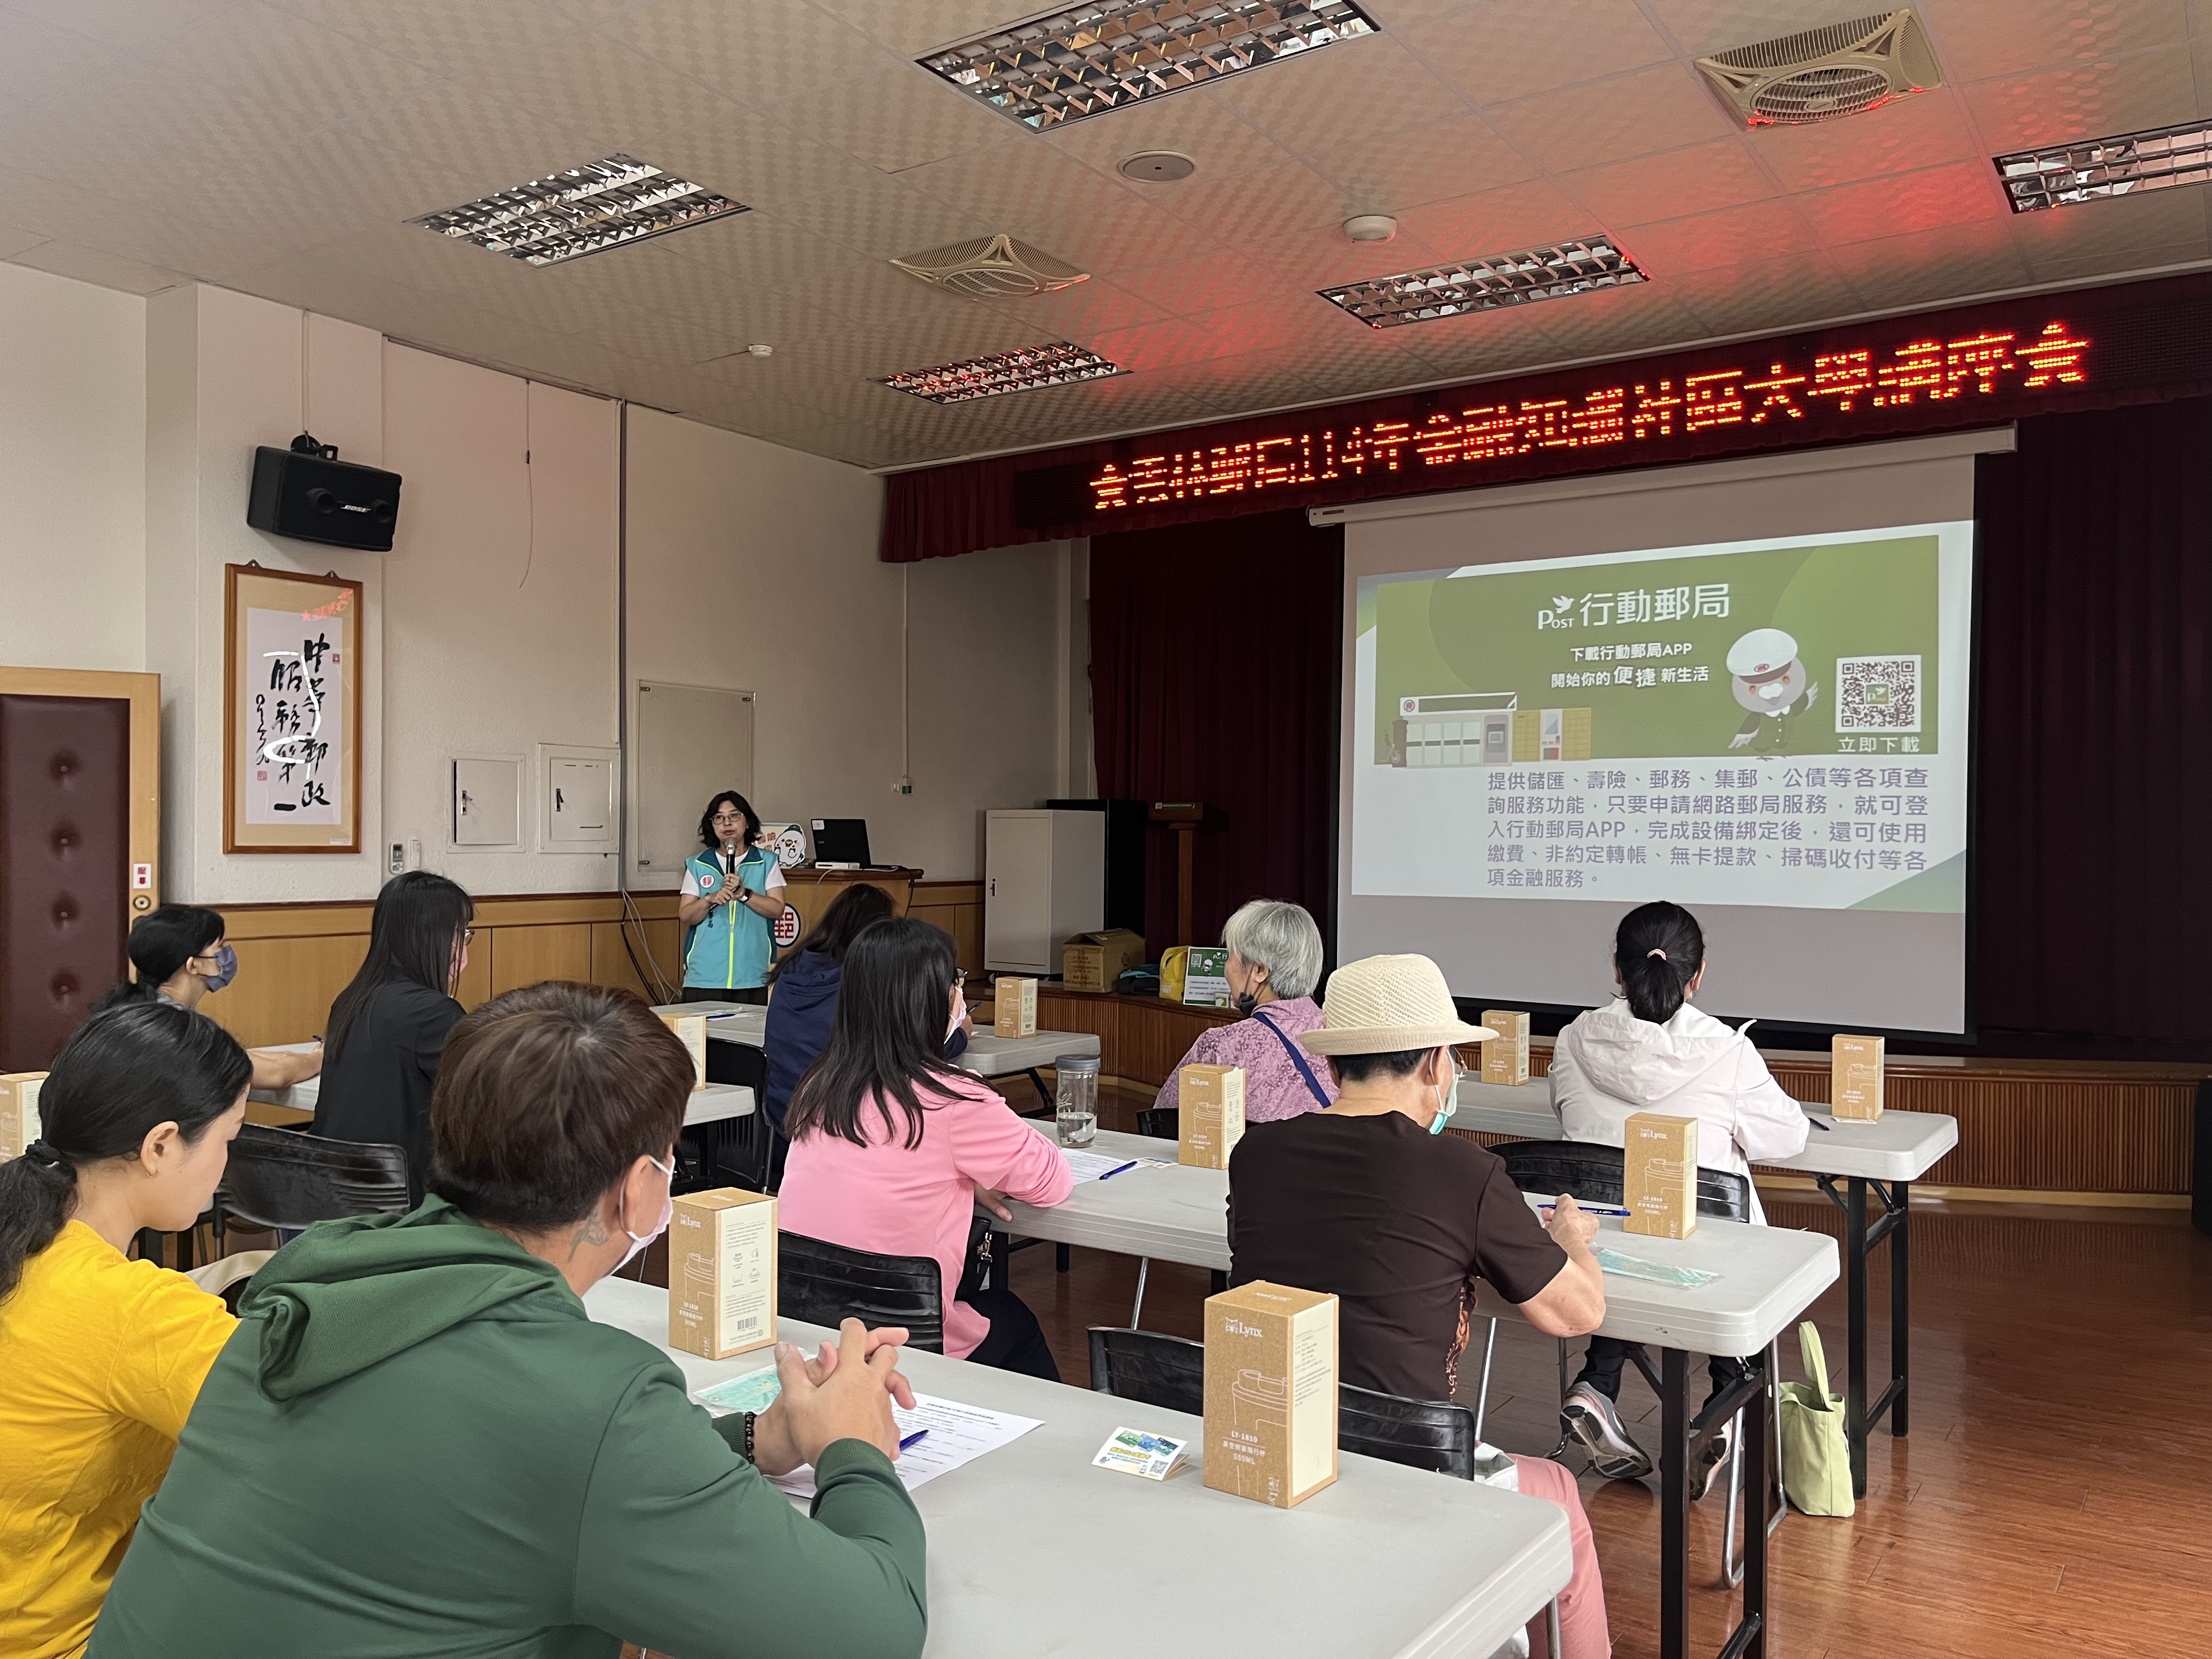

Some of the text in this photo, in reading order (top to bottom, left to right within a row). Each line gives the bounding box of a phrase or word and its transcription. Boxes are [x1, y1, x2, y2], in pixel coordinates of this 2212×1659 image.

[341, 505, 371, 513] BOSE
[1580, 583, 1730, 627] 行動郵局
[1570, 643, 1692, 662] 下載行動郵局APP
[1838, 736, 1920, 753] 立即下載
[1488, 767, 1928, 791] 提供儲匯、壽險、郵務、集郵、公債等各項查
[1488, 794, 1928, 815] 詢服務功能，只要申請網路郵局服務，就可登
[1488, 820, 1926, 843] 入行動郵局APP，完成設備綁定後，還可使用
[1487, 844, 1927, 871] 繳費、非約定轉帳、無卡提款、掃碼收付等各
[1487, 868, 1598, 888] 項金融服務。
[1197, 1079, 1209, 1088] Lynx
[1650, 1130, 1668, 1139] Lynx
[687, 1216, 701, 1228] Lynx
[1239, 1322, 1263, 1338] Lynx
[1232, 1430, 1258, 1443] LY-1810
[1233, 1453, 1256, 1465] 550ML
